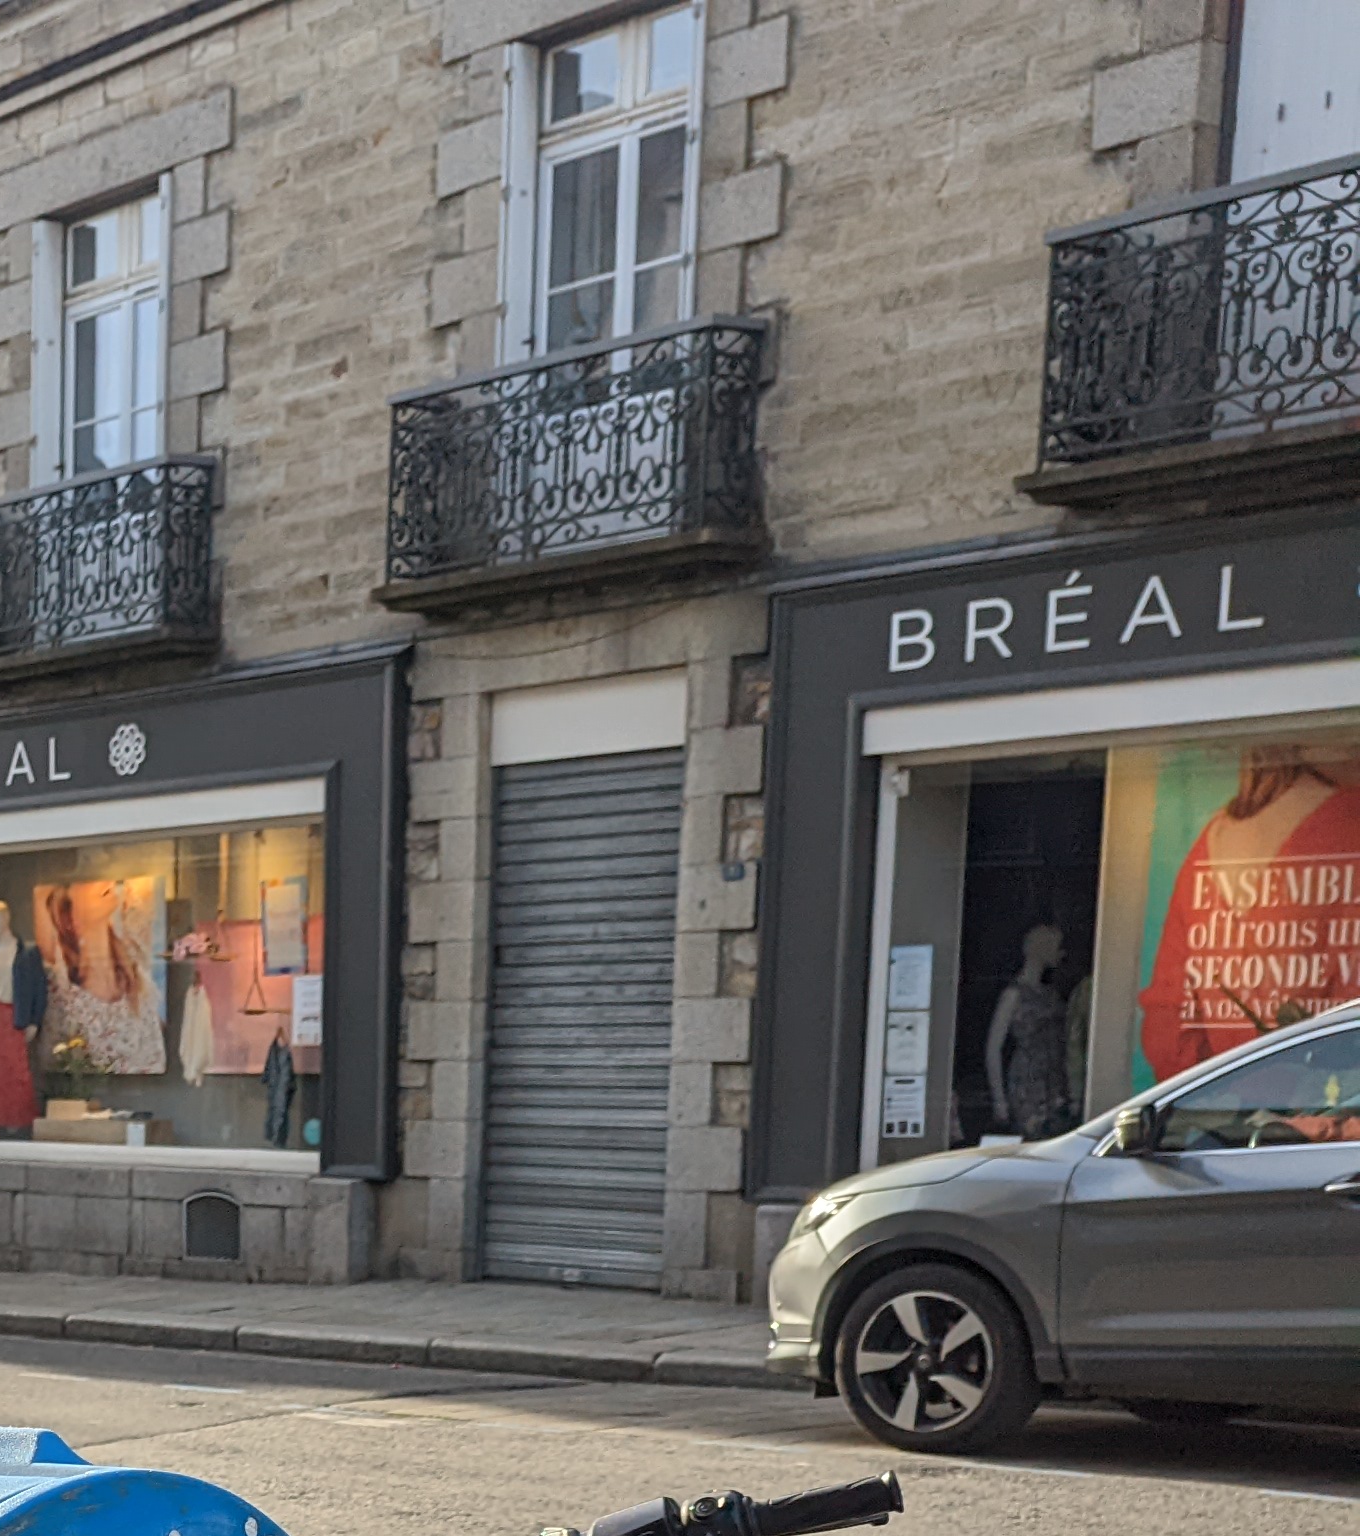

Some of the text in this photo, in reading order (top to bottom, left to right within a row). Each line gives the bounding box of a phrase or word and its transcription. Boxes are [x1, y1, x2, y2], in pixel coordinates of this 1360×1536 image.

[888, 565, 1267, 673] BRÉAL
[1188, 910, 1317, 950] offrons
[1184, 953, 1330, 990] SECONDE
